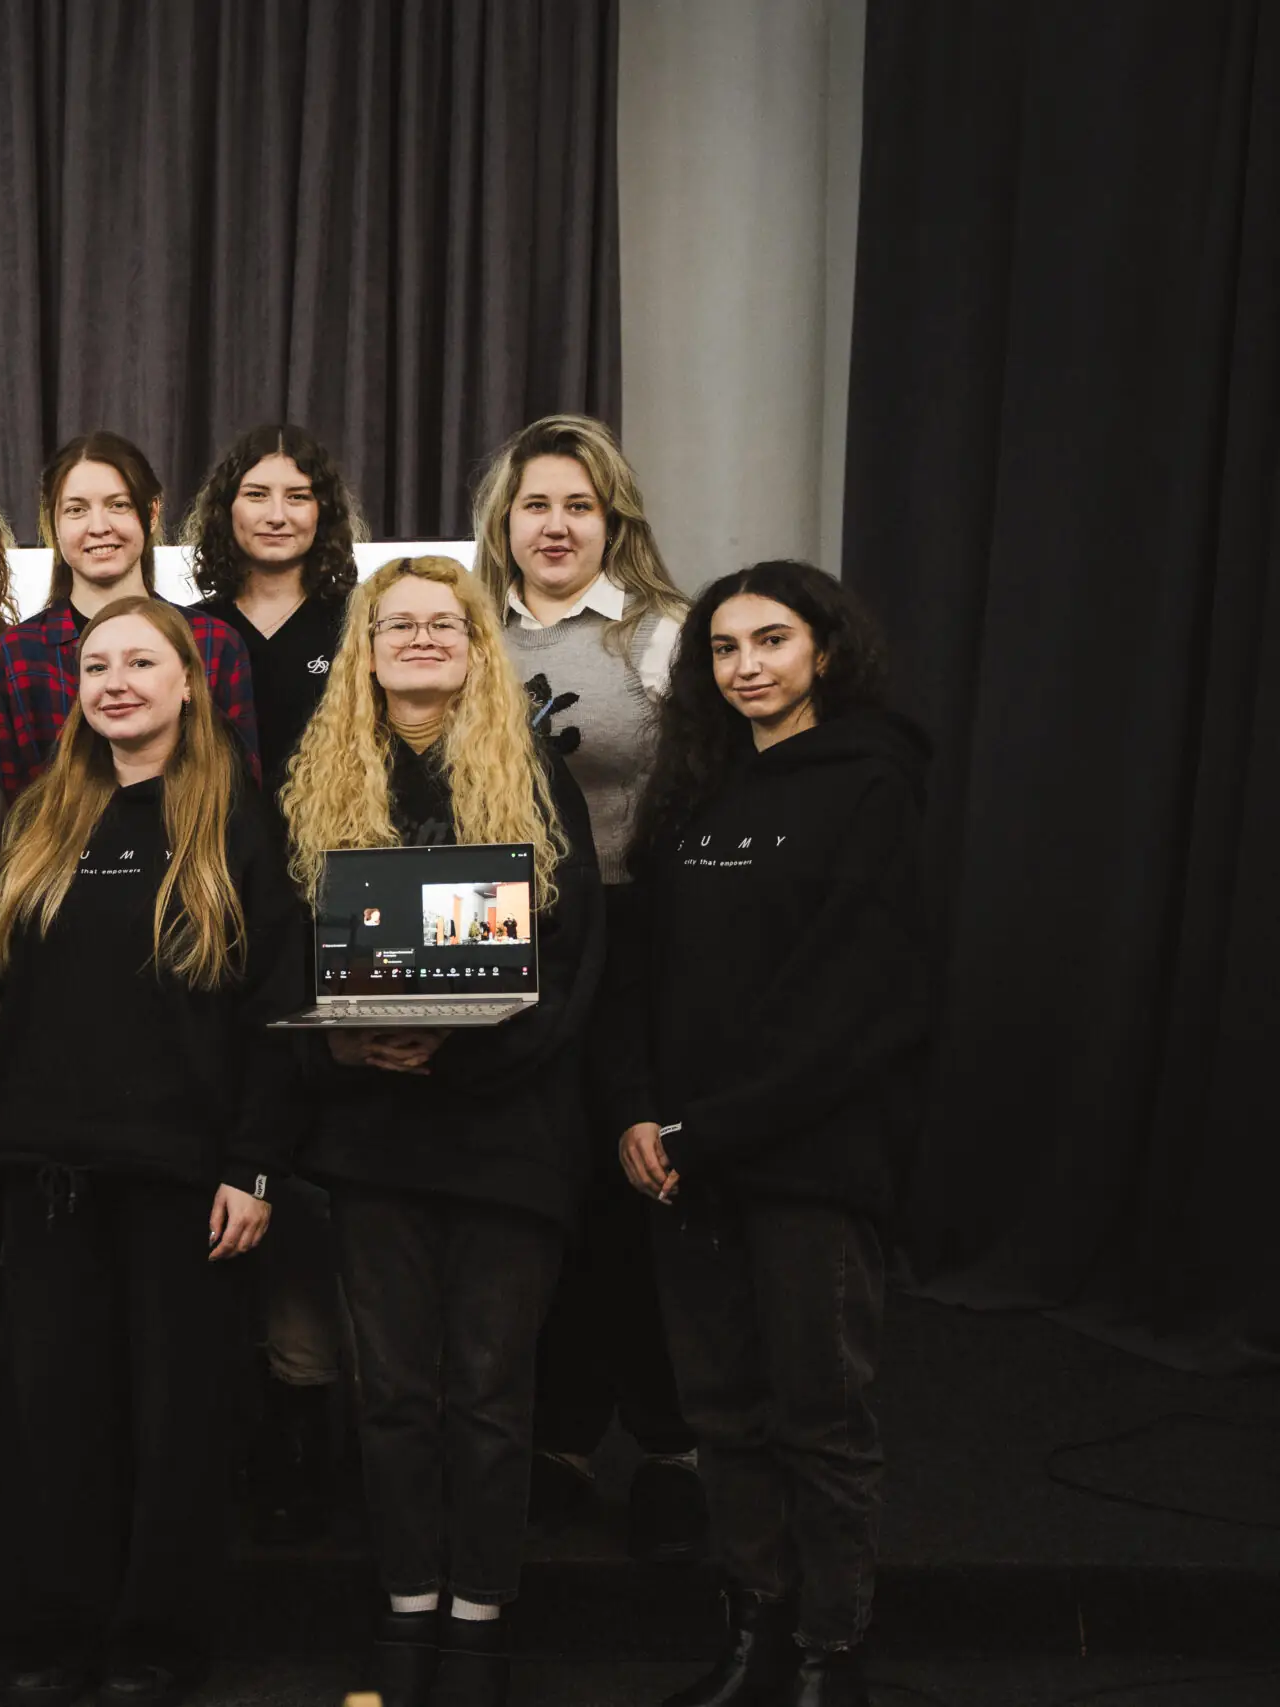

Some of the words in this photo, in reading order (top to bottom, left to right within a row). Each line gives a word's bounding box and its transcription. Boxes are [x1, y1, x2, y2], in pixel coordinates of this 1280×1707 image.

[80, 850, 173, 860] UMY
[684, 858, 697, 866] city
[699, 858, 717, 866] that
[719, 858, 753, 867] empowers
[101, 868, 141, 876] empowers
